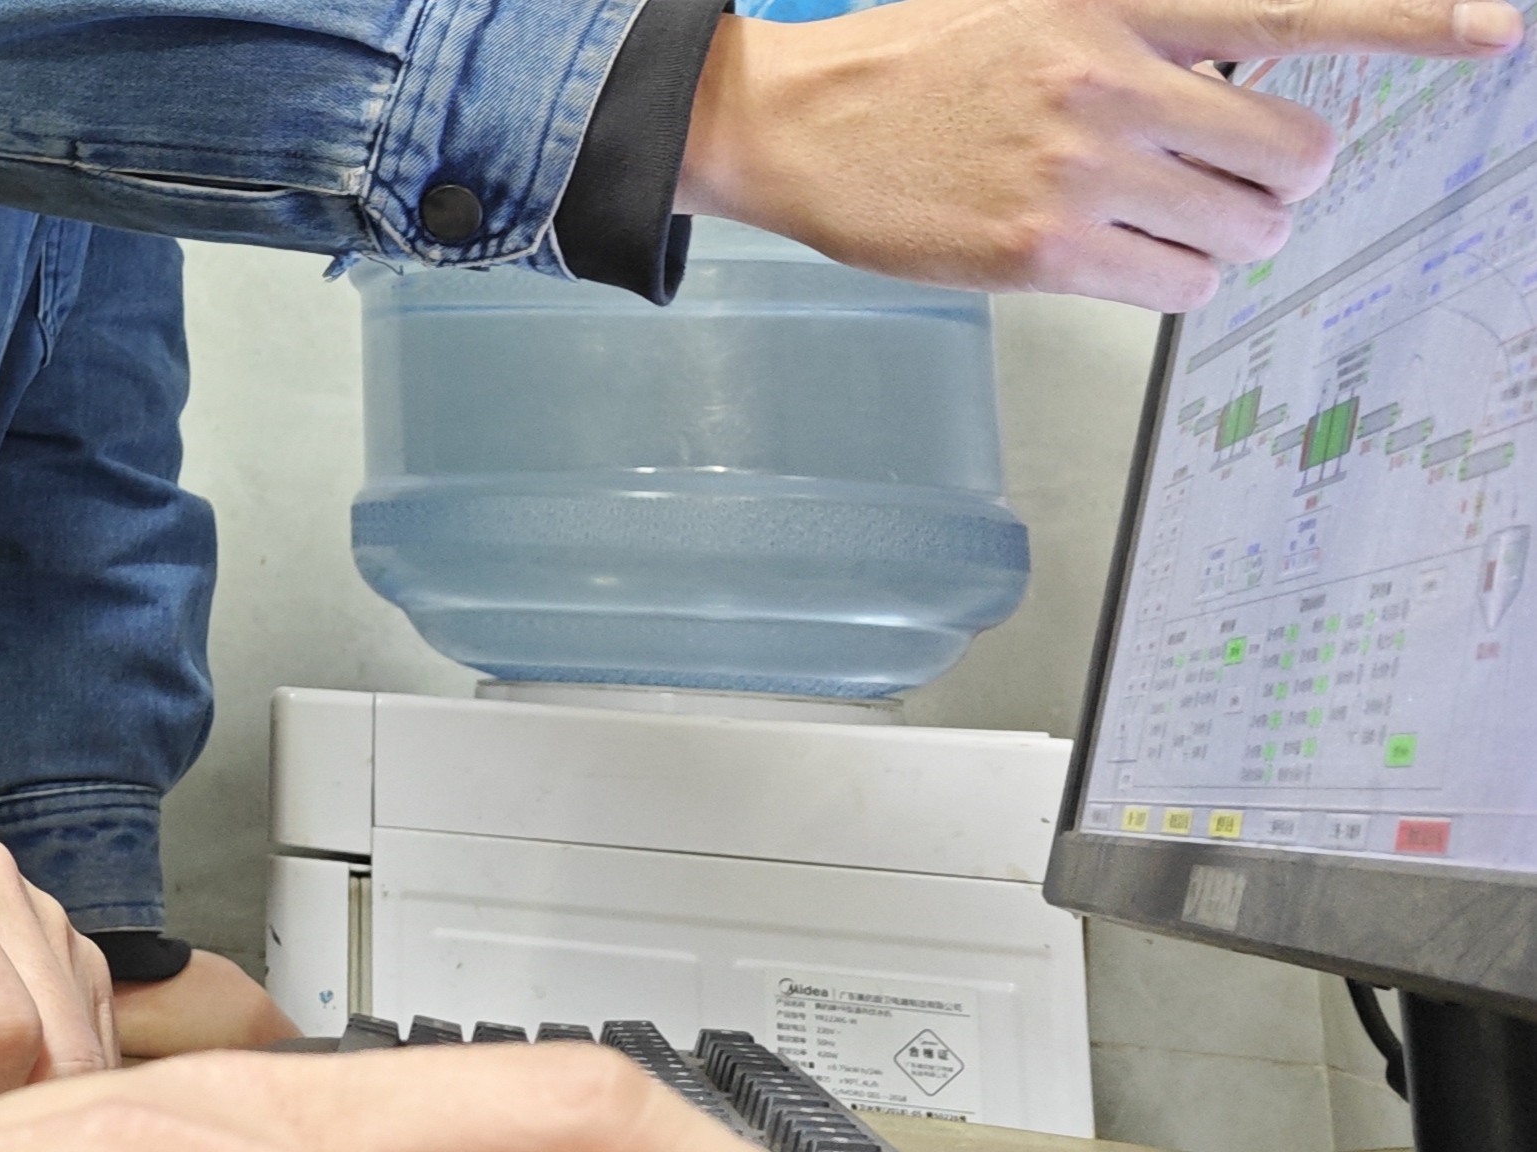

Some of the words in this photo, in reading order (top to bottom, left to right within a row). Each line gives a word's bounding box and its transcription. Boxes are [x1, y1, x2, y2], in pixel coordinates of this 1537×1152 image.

[781, 979, 829, 997] Midea
[909, 1046, 949, 1060] 合格证
